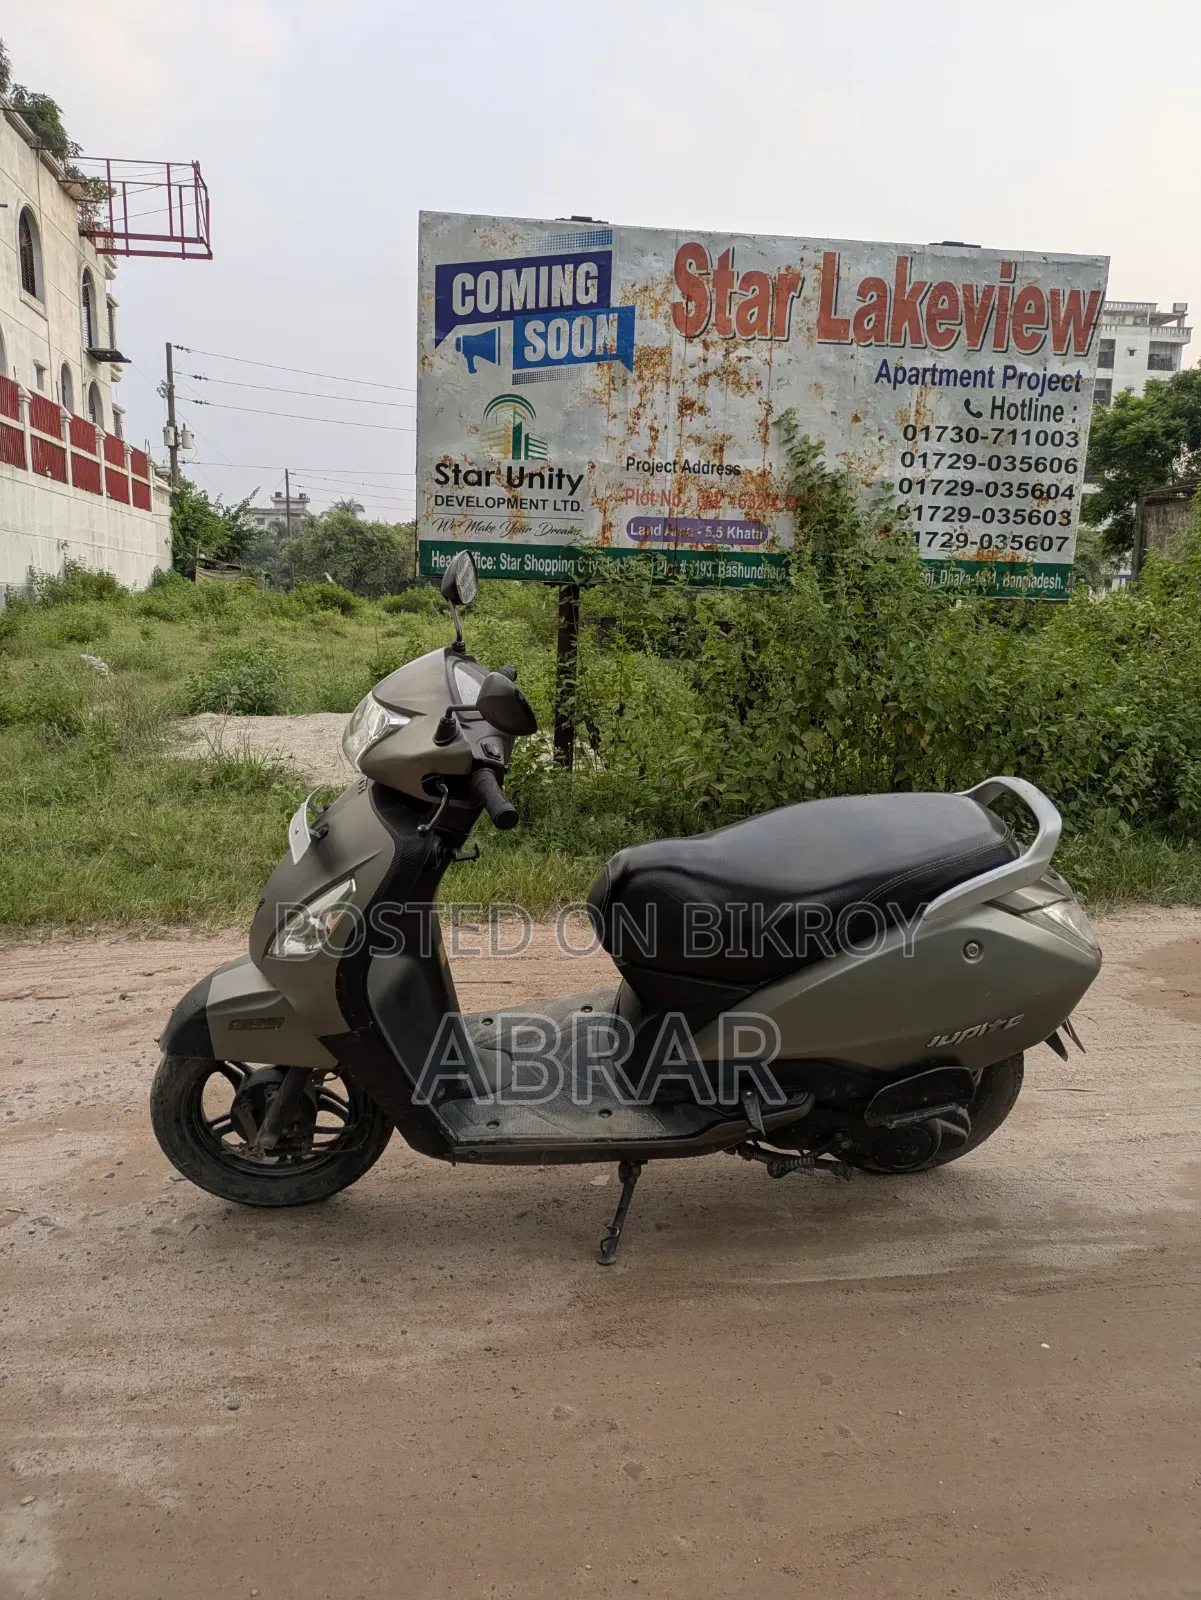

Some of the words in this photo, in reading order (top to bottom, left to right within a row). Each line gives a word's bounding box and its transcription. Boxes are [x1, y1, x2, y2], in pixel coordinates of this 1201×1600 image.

[452, 261, 599, 316] COMING
[670, 241, 804, 342] Star
[816, 251, 1102, 356] Lakeview
[523, 312, 619, 362] SOON
[874, 358, 996, 390] Apartment
[1001, 364, 1083, 397] Project
[989, 395, 1065, 423] Hotline
[902, 424, 1080, 448] 01730-711003
[626, 456, 677, 477] Project
[681, 459, 742, 476] Address
[900, 451, 1079, 474] 01729-035606
[434, 462, 495, 487] Star
[506, 465, 585, 496] Unity
[898, 477, 1076, 501] 01729-035604
[434, 495, 549, 511] DEVELOPMENT
[553, 500, 585, 512] LTD.
[625, 487, 656, 506] Plot
[896, 504, 1072, 527] 01729-035603
[432, 518, 458, 532] We
[458, 519, 496, 535] Make
[499, 521, 533, 538] Your
[630, 522, 661, 537] Land
[726, 526, 763, 541] Khata
[896, 531, 1070, 552] 1729-035607
[431, 550, 459, 568] Hea
[500, 552, 520, 571] Star
[524, 553, 575, 578] Shopping
